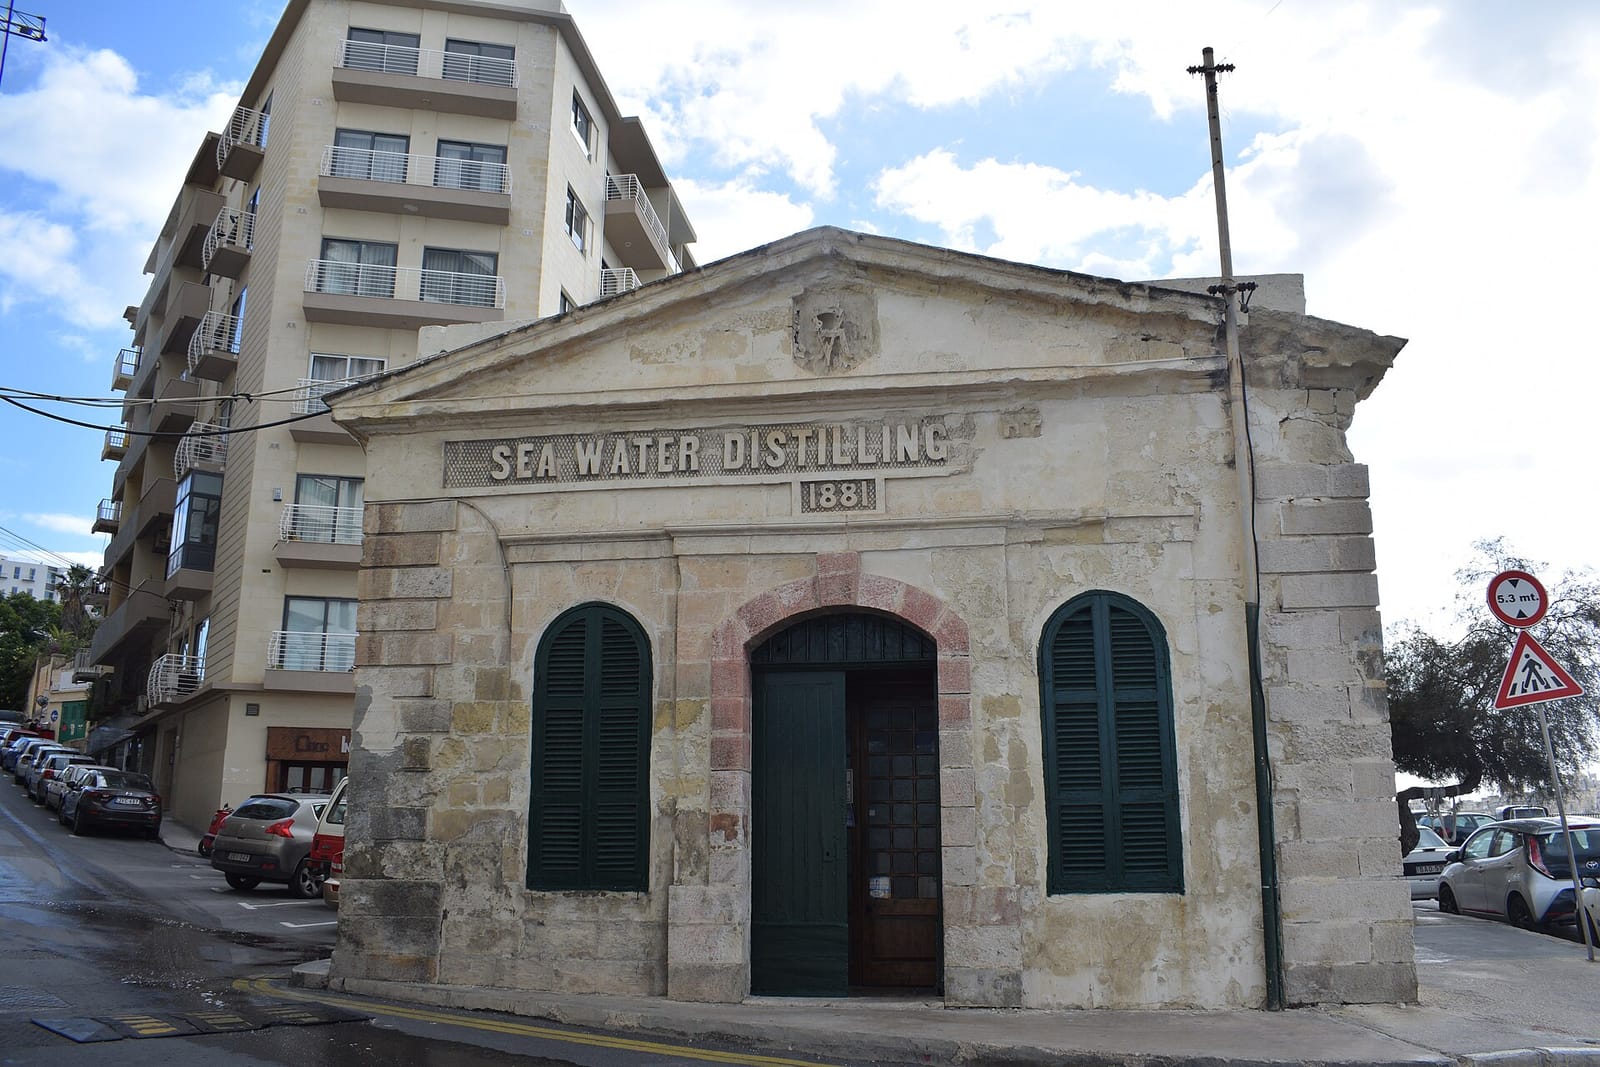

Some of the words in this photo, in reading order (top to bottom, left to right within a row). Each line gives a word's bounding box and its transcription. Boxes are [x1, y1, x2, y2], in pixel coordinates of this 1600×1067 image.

[490, 442, 557, 480] SEA
[576, 435, 700, 475] WATER
[723, 423, 949, 469] DISTILLING
[809, 480, 868, 509] 1881
[1497, 594, 1515, 603] 5.3
[1519, 593, 1539, 602] mt.
